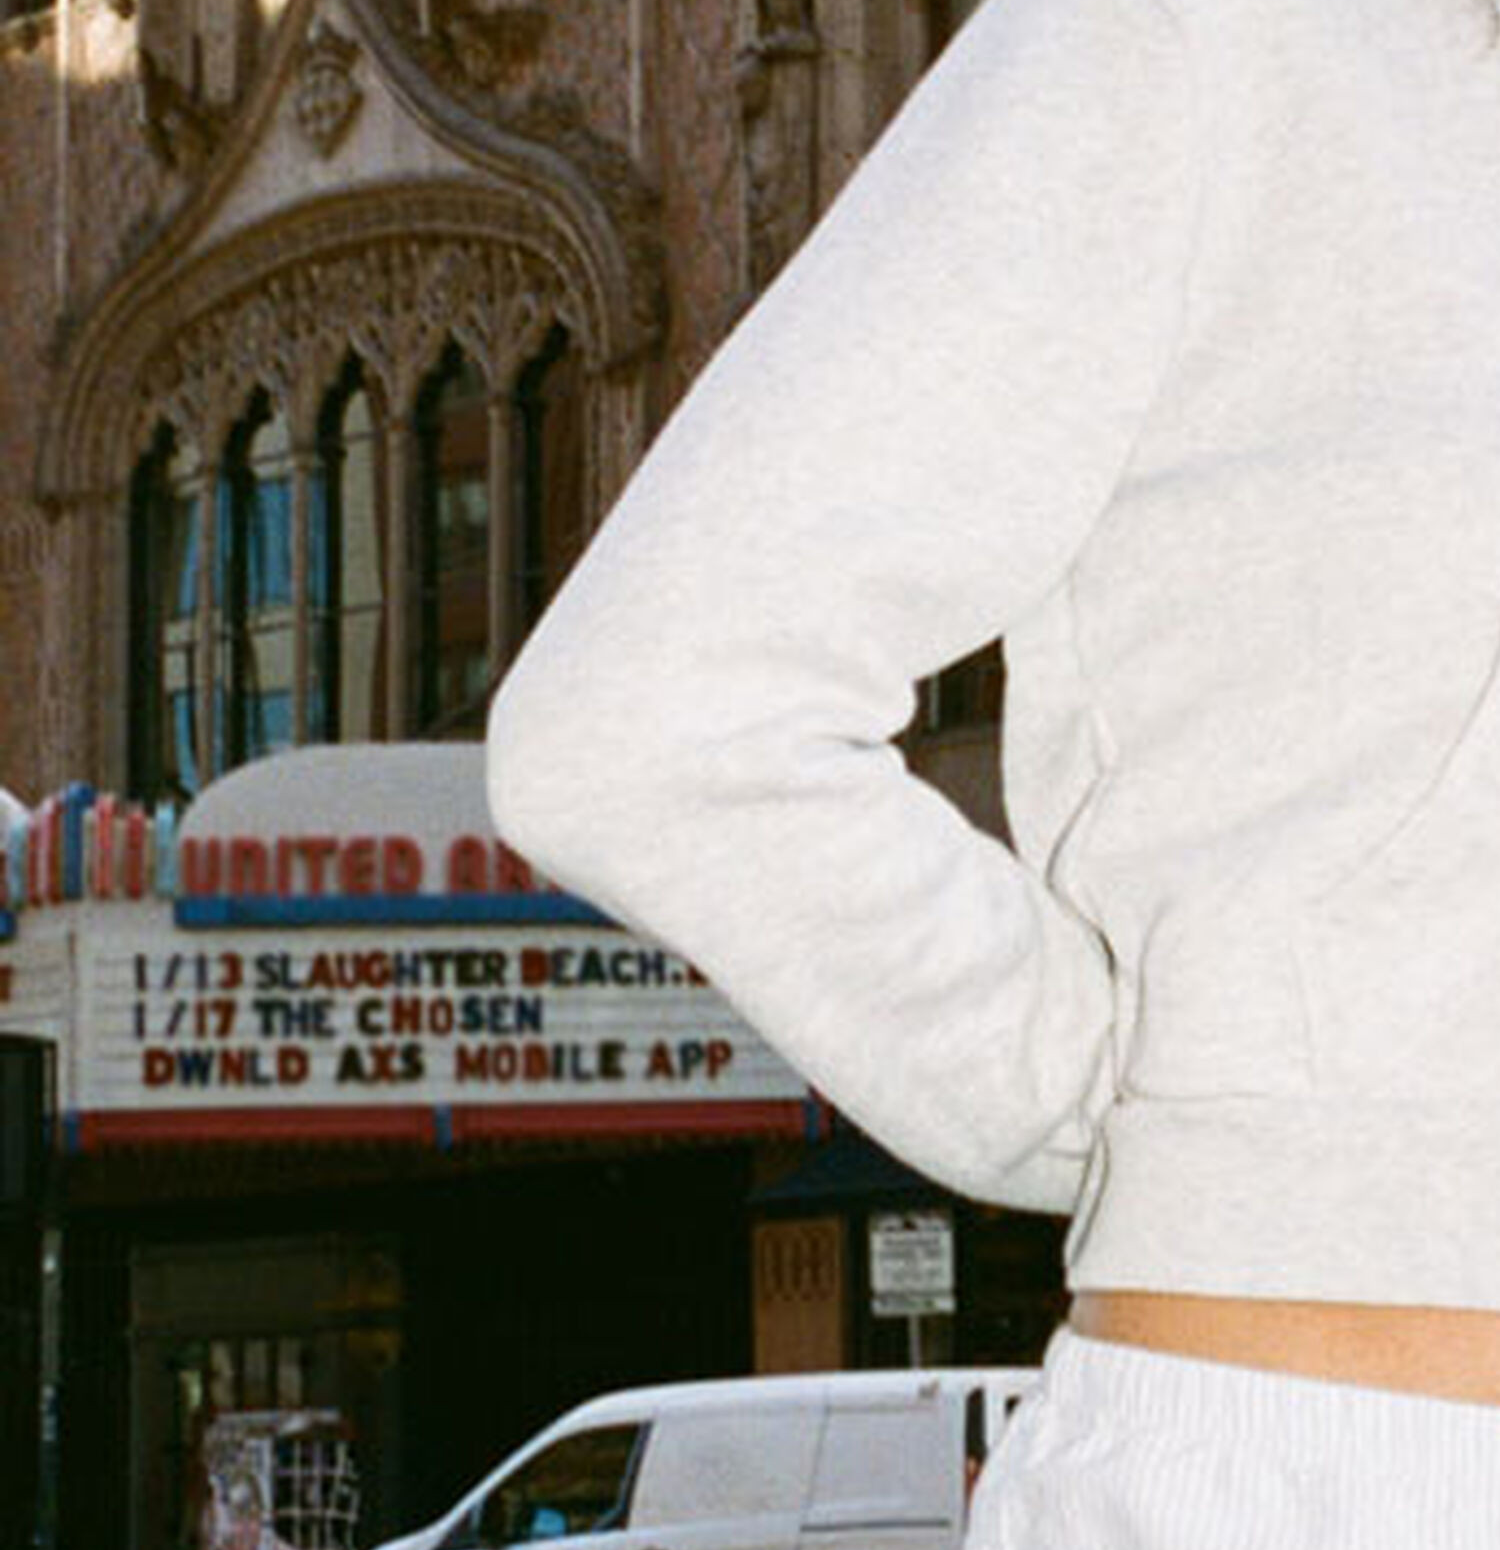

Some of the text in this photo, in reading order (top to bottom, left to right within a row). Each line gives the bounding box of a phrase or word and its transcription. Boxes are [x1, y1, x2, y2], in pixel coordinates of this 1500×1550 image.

[181, 835, 422, 894] UNITED
[255, 950, 506, 990] SLAUGHTER
[134, 996, 541, 1039] 1/17 THE CHOSEN
[142, 1039, 733, 1087] DWNLD AXS MOBILE APP
